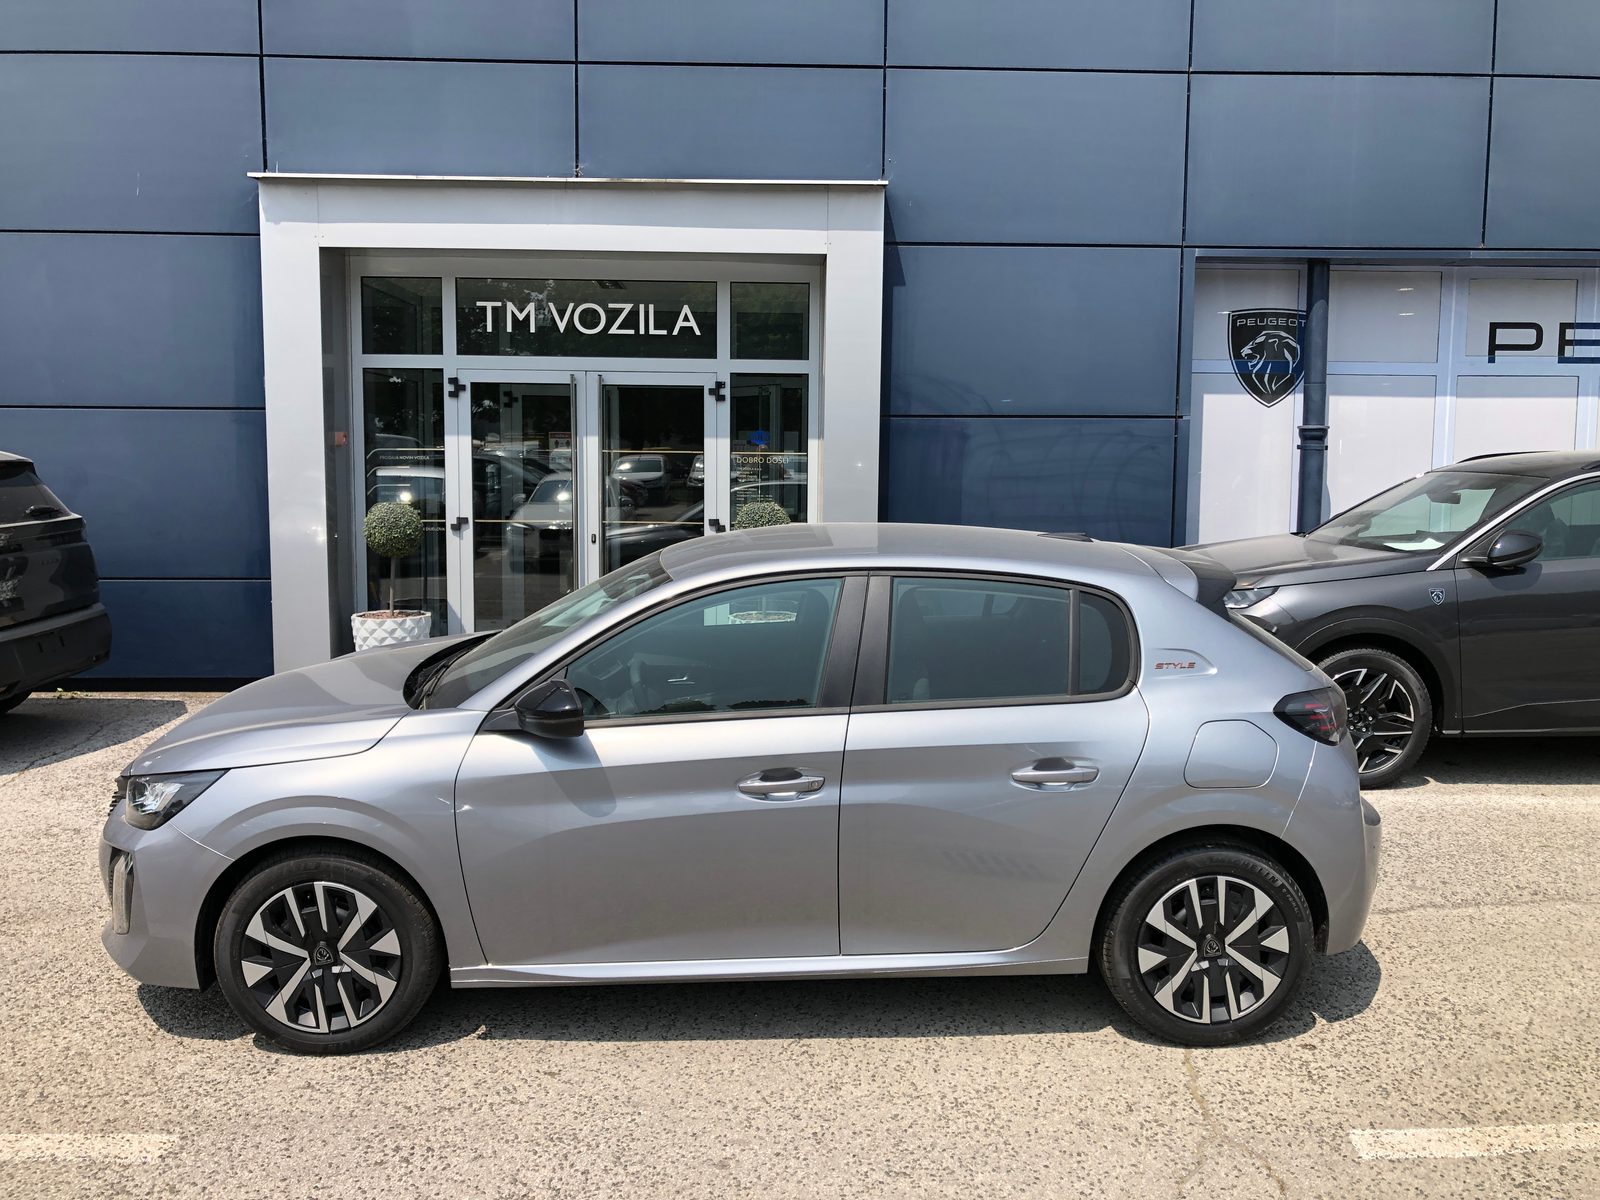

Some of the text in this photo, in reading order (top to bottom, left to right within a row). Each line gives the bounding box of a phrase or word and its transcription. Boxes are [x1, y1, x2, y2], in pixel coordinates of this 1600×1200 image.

[476, 301, 702, 336] TM VOZILA
[1236, 317, 1306, 327] PEUGEOT
[1488, 322, 1600, 364] PE
[736, 455, 789, 464] DOBRO DOŠLI
[1154, 662, 1196, 670] STYLE
